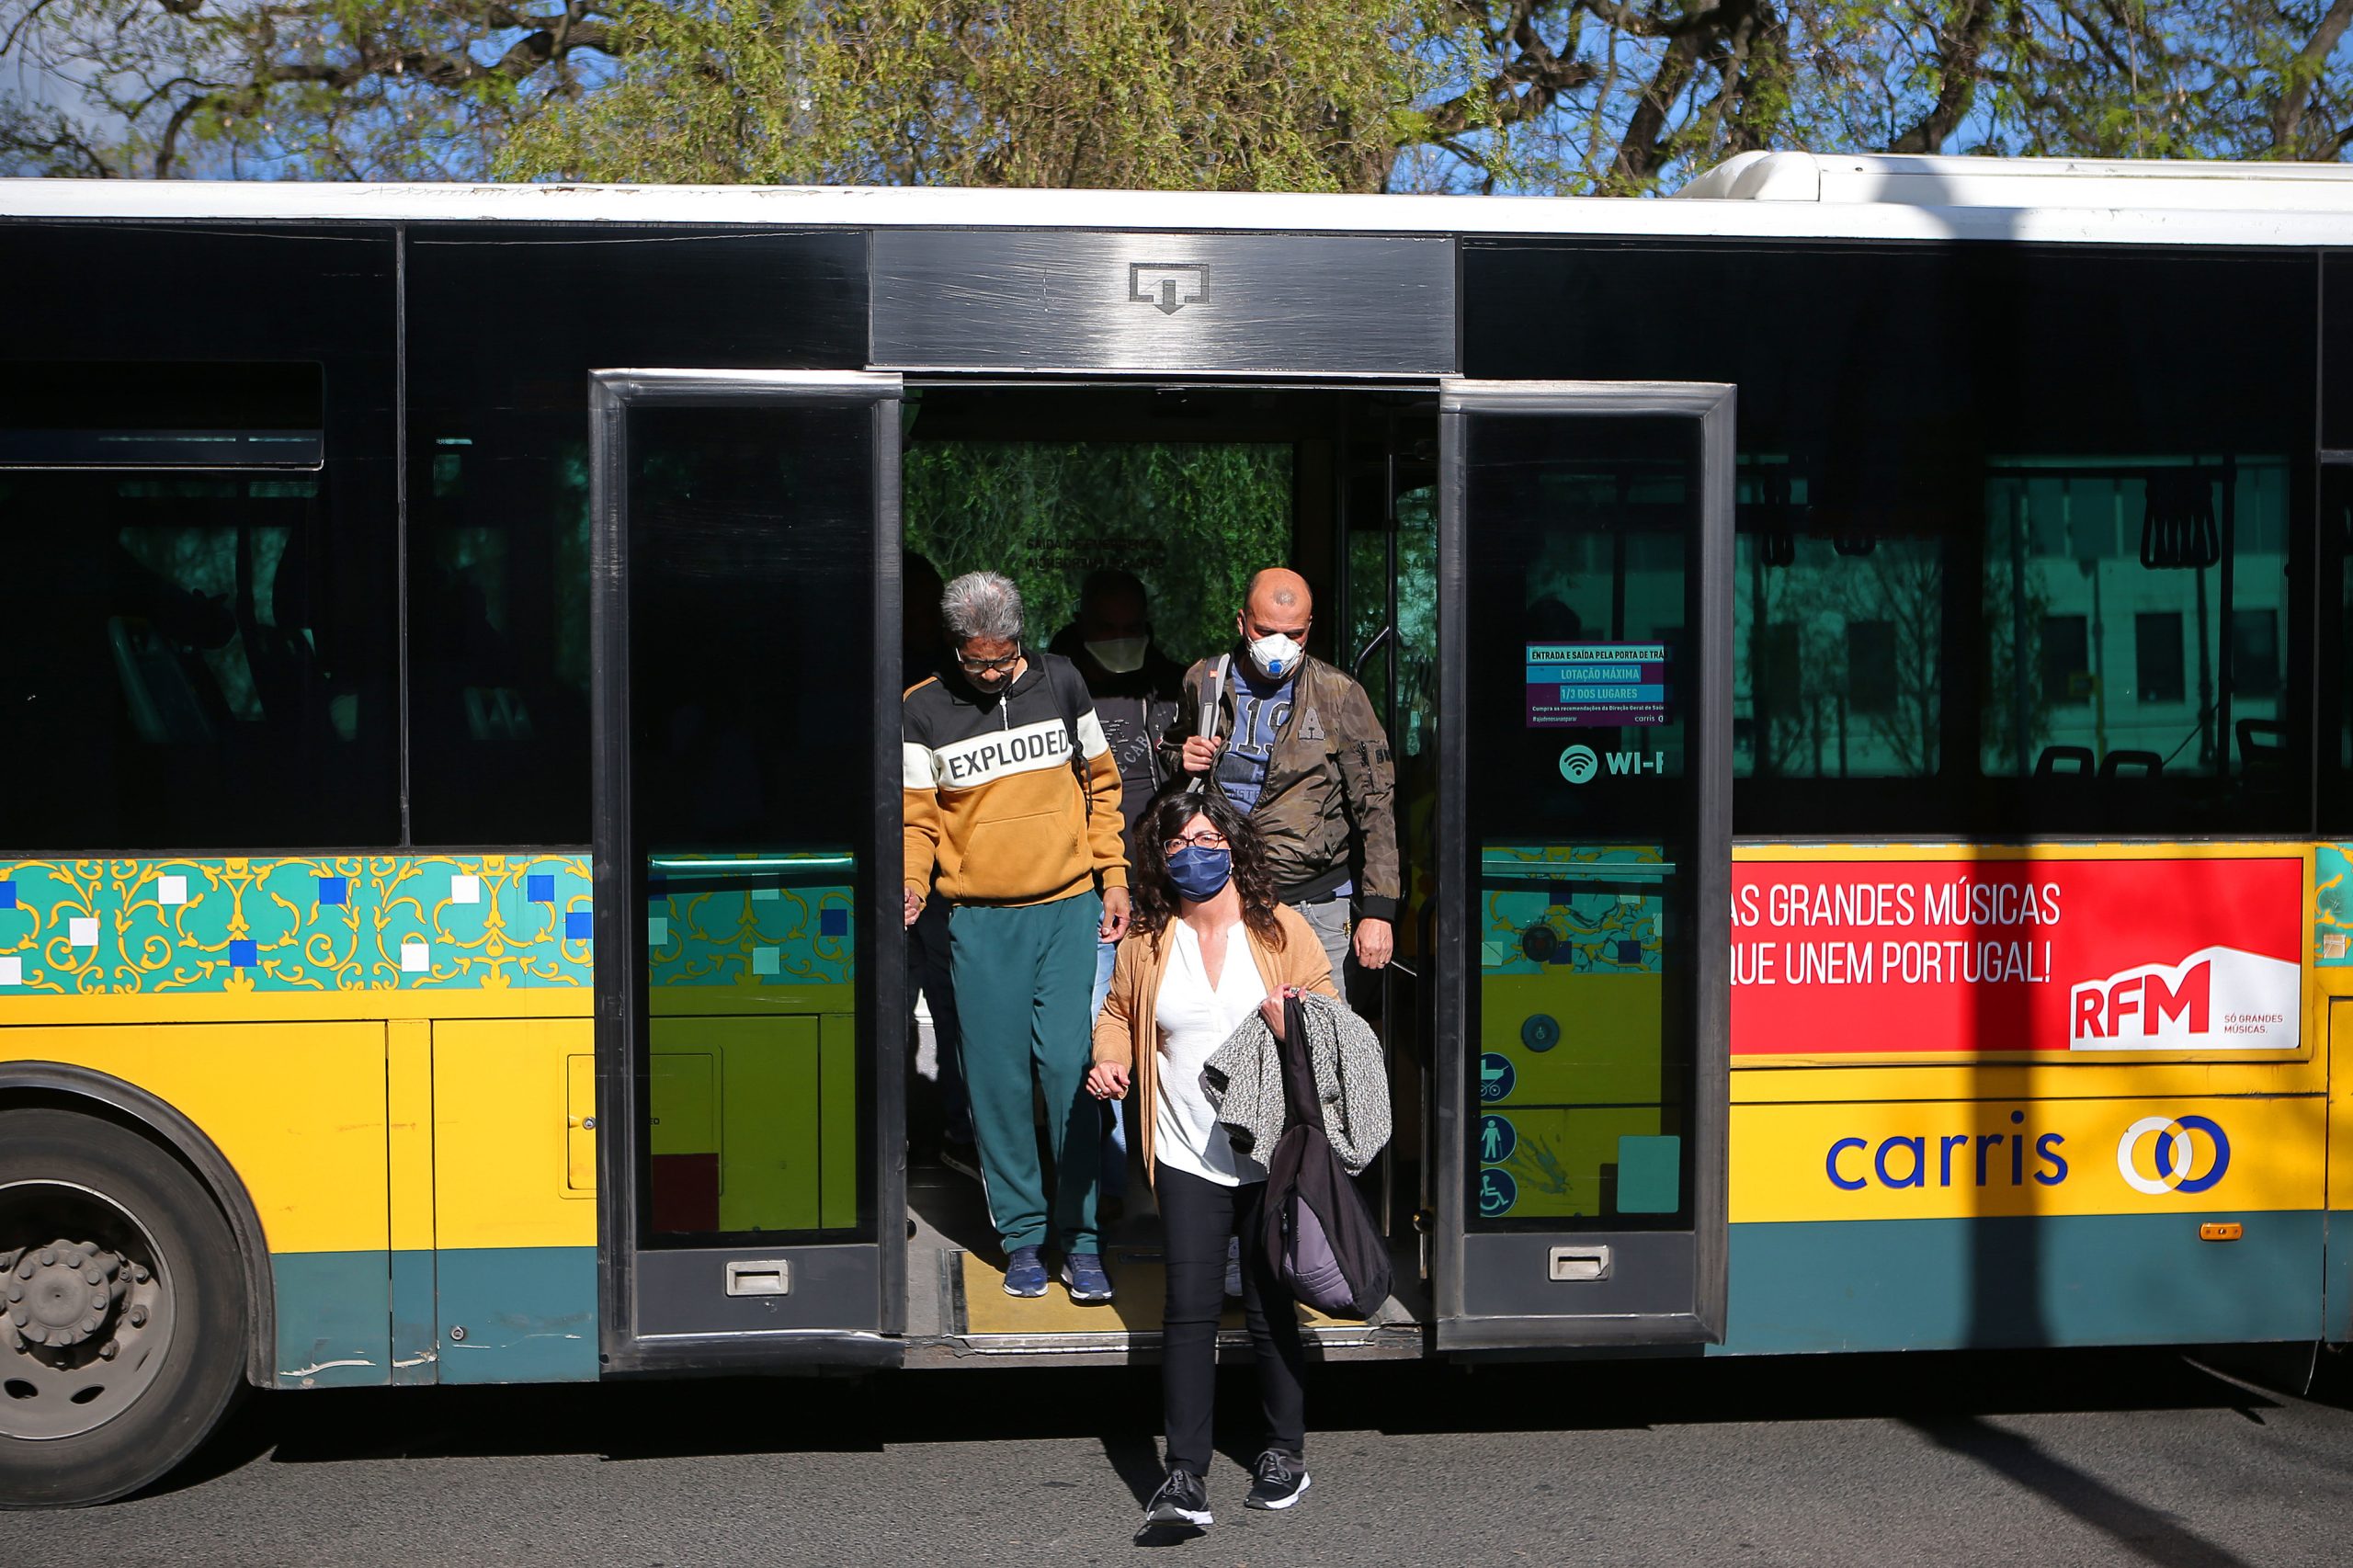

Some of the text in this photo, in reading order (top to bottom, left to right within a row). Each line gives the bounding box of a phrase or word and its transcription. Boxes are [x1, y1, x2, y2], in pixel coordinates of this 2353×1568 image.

[1532, 651, 1564, 660] ENTRADA
[1566, 651, 1571, 659] E
[1572, 649, 1594, 659] SAÍDA
[1596, 651, 1613, 659] PELA
[1615, 651, 1638, 659] PORTA
[1640, 651, 1648, 659] DE
[1561, 667, 1640, 682] LOTAÇÃO MÁXIMA
[1562, 688, 1638, 699] 1/3 DOS LUGARES
[1634, 713, 1655, 722] carris
[949, 729, 1068, 779] EXPLODED
[1769, 883, 1915, 926] GRANDES
[1924, 875, 2062, 926] MÚSICAS
[1786, 941, 1873, 985] UNEM
[1881, 939, 2052, 984] PORTUGAL!
[2075, 960, 2211, 1040] RFM
[2224, 1013, 2283, 1023] SÓ GRANDES
[1825, 1110, 2069, 1190] carris
